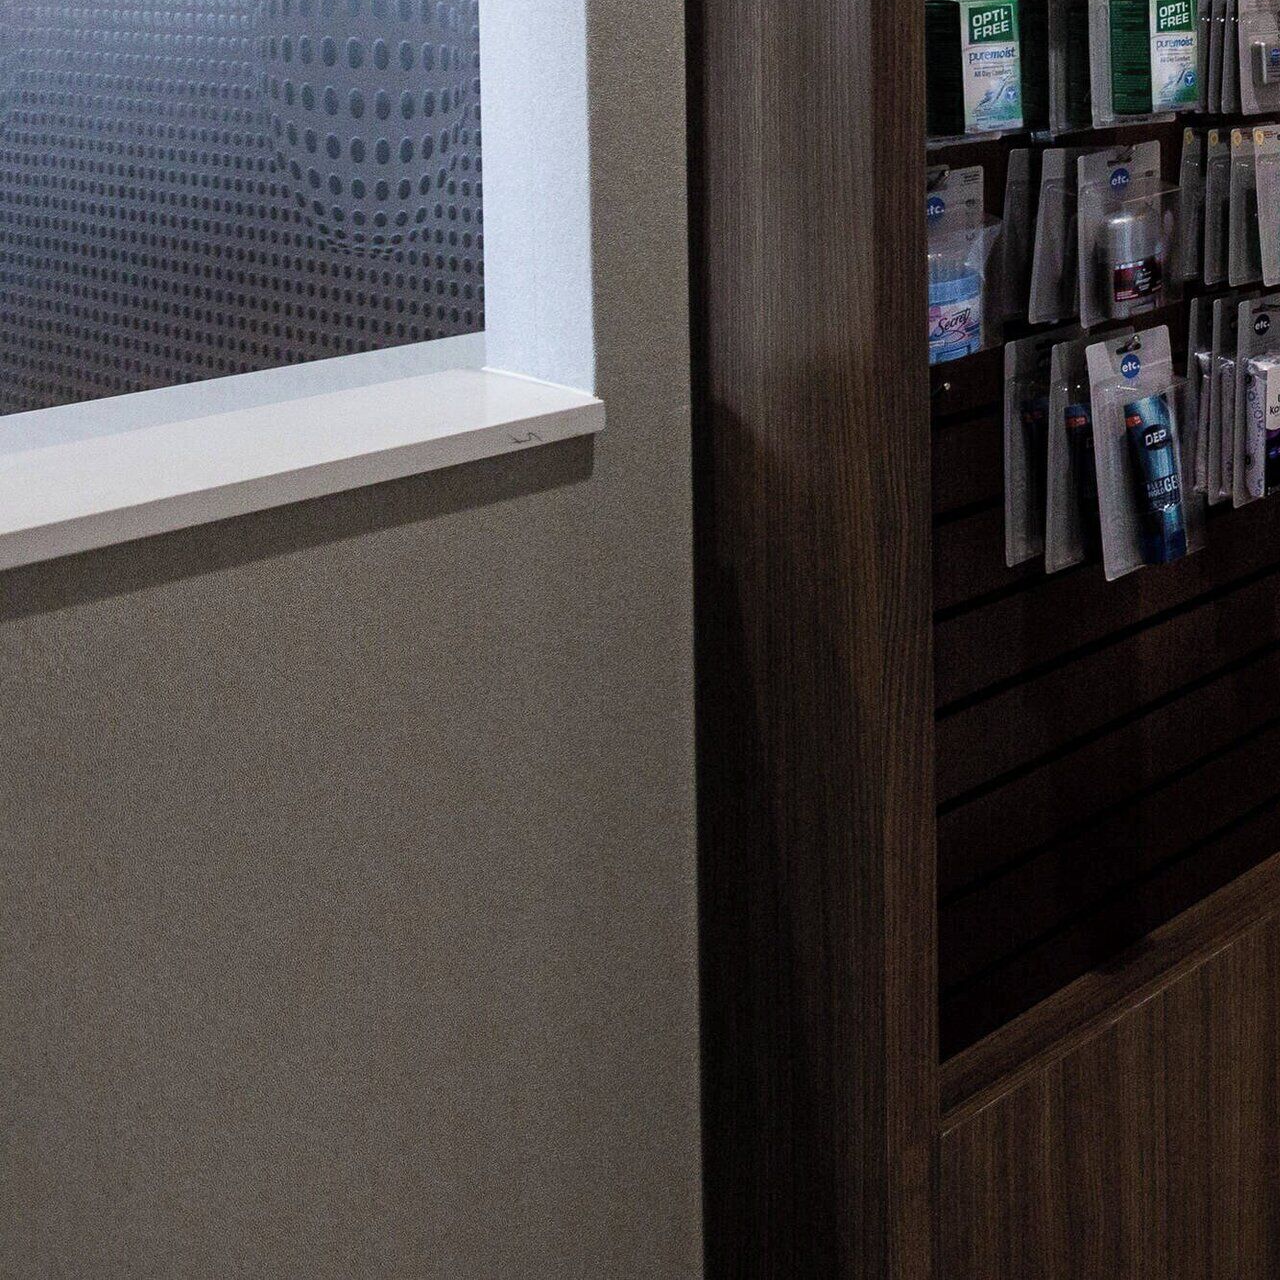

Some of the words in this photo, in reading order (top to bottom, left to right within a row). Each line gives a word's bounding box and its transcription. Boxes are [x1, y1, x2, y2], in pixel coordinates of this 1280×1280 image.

[972, 7, 1009, 27] OPTI-
[1159, 1, 1189, 19] OPTI-
[1160, 12, 1189, 29] FREE
[973, 21, 1010, 40] FREE
[1156, 37, 1194, 51] puremoist
[969, 47, 1017, 65] puremoist
[1144, 429, 1168, 448] DEP
